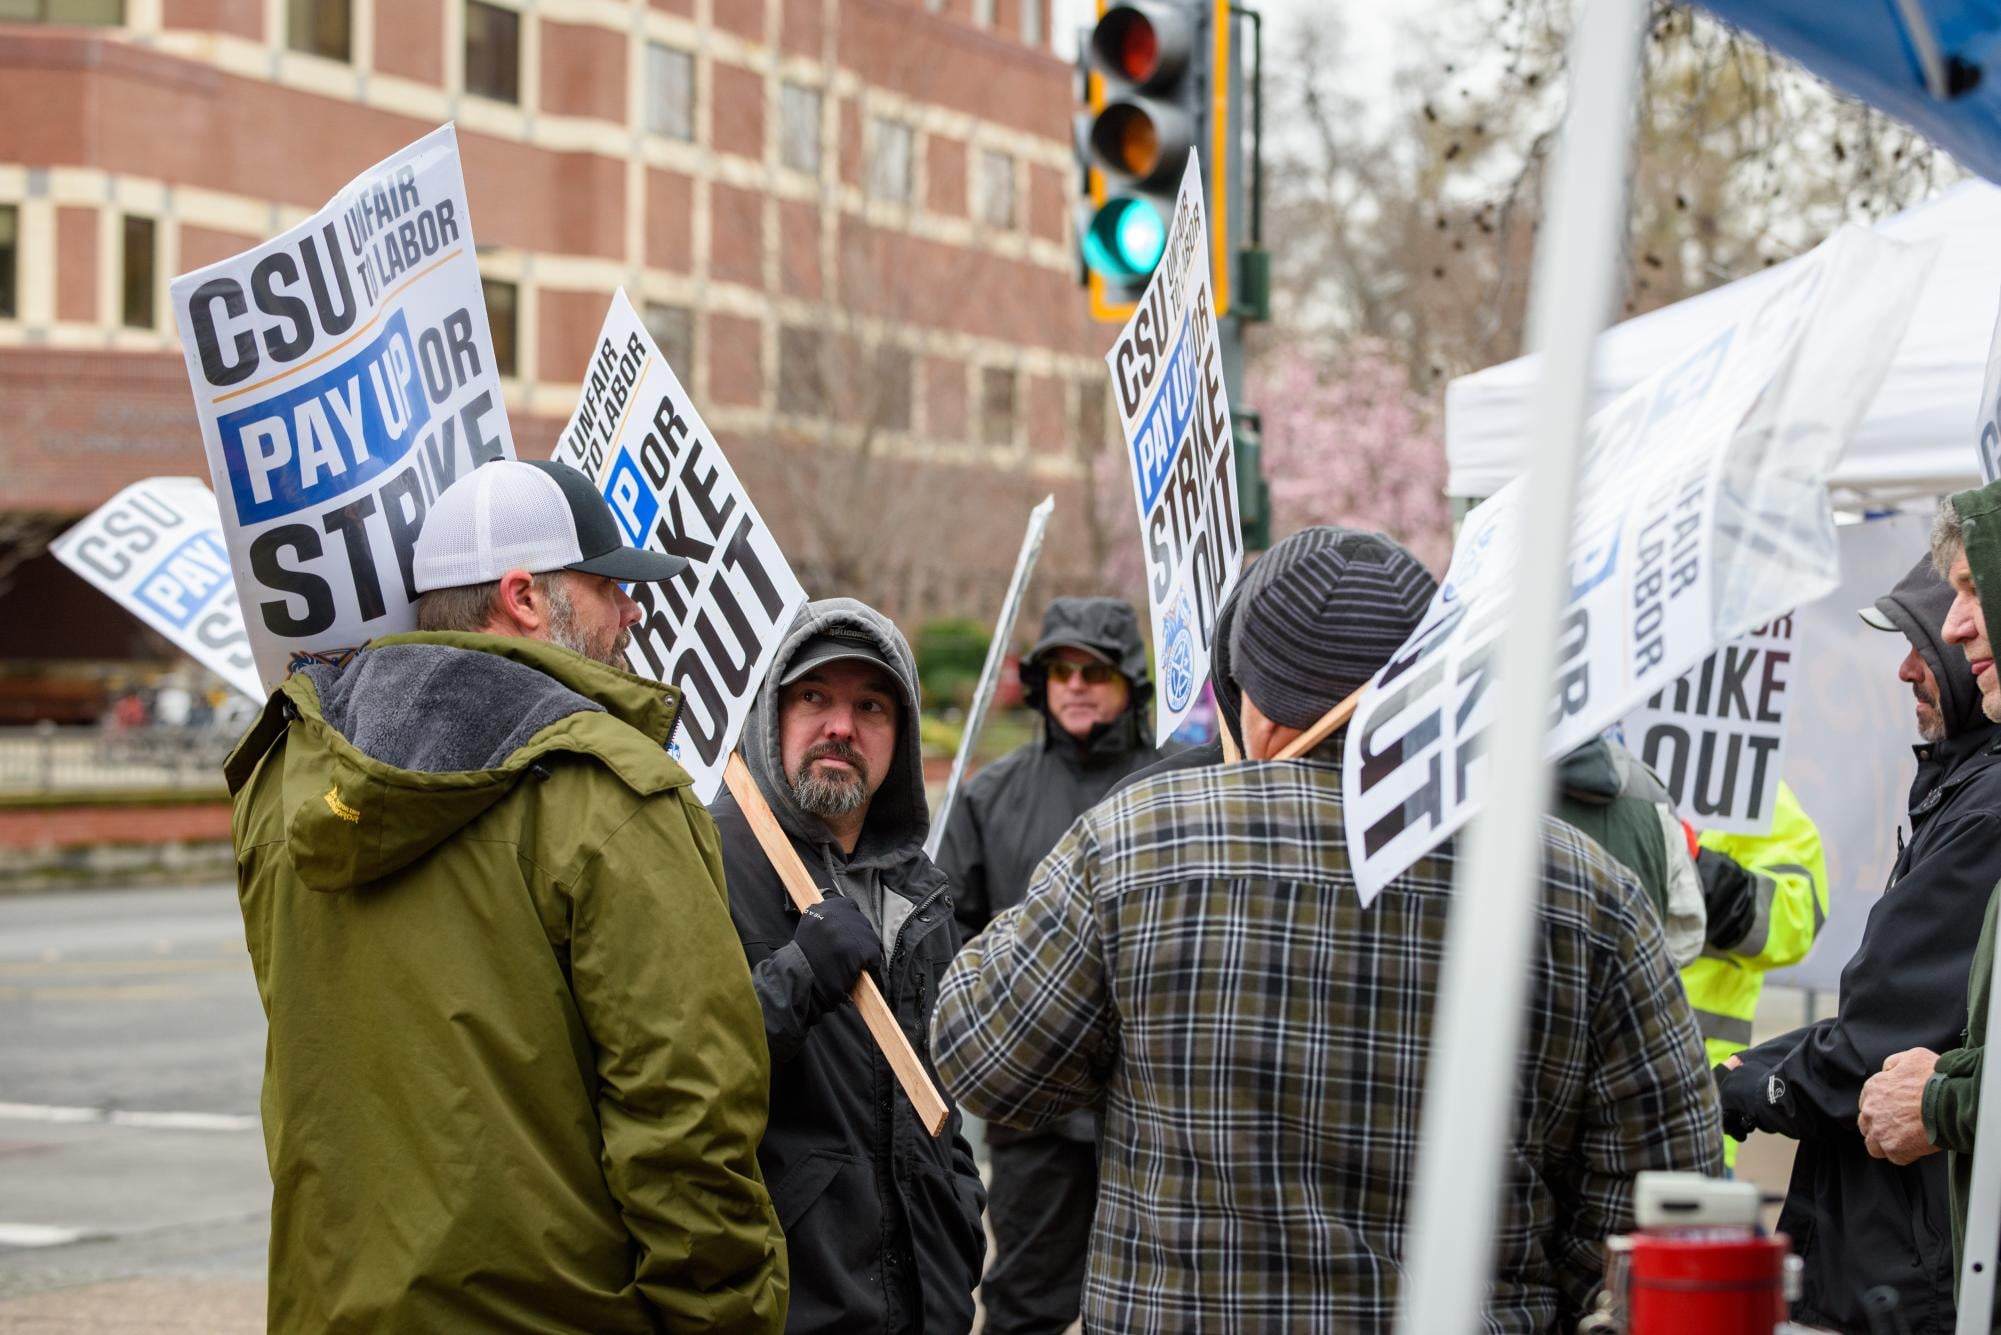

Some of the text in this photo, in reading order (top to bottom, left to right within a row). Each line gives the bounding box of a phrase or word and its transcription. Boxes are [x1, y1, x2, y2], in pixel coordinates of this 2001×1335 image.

[188, 221, 358, 386] CSU
[357, 198, 460, 307] TO LABOR
[238, 382, 364, 504] PAY
[367, 340, 414, 442] UP
[418, 307, 483, 406] OR
[568, 337, 618, 460] UNFAIR
[582, 331, 647, 484] TO LABOR
[1117, 270, 1169, 419] CSU
[1138, 281, 1210, 500] PAY UP OR
[639, 395, 688, 491] OR
[1149, 341, 1226, 606] STRIKE
[77, 489, 186, 582] CSU
[624, 438, 737, 682] RIKE
[1192, 438, 1237, 652] OUT
[1635, 511, 1669, 679] LABOR
[671, 512, 784, 767] OUT
[1647, 645, 1791, 724] RIKE
[1641, 723, 1780, 821] OUT
